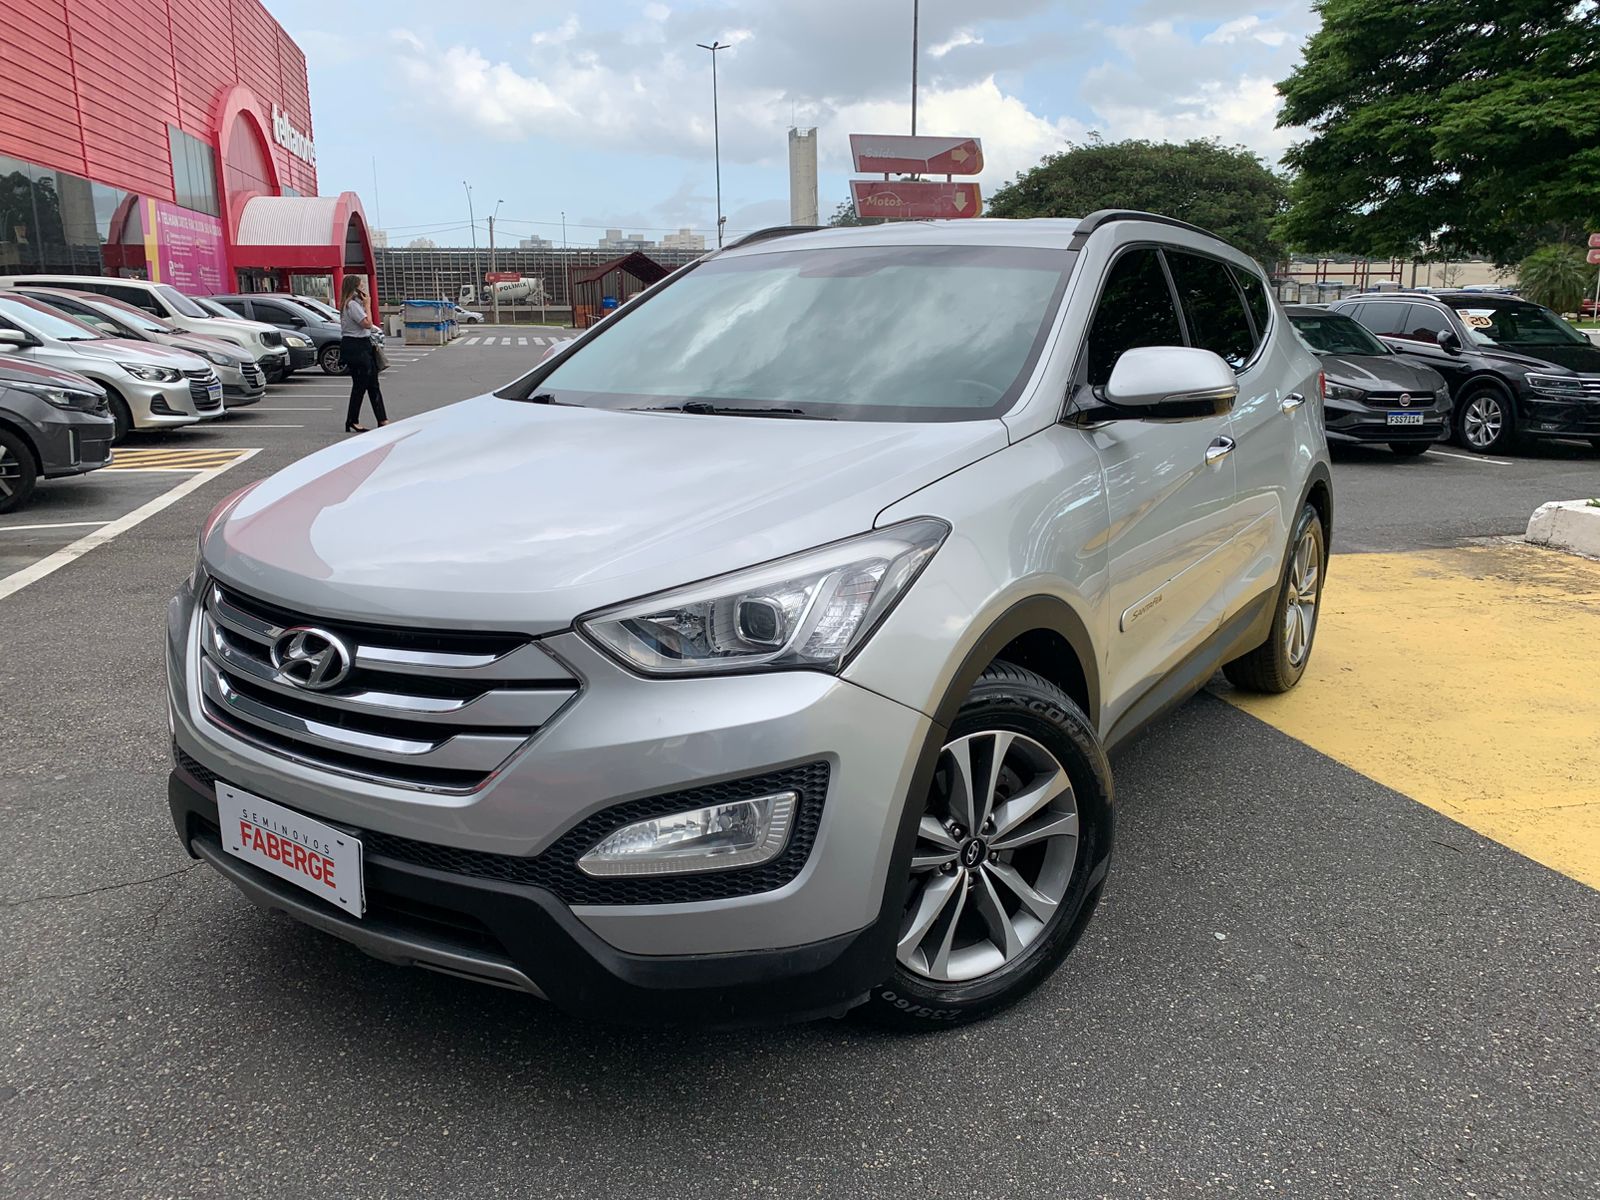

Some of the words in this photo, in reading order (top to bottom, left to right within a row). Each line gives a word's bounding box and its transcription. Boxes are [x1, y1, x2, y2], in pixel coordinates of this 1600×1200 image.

[271, 102, 317, 167] telhanorte
[866, 196, 901, 207] Motos
[499, 282, 527, 292] POLIMIX
[242, 809, 330, 854] SEMINOVOS
[239, 820, 337, 890] FABERGE
